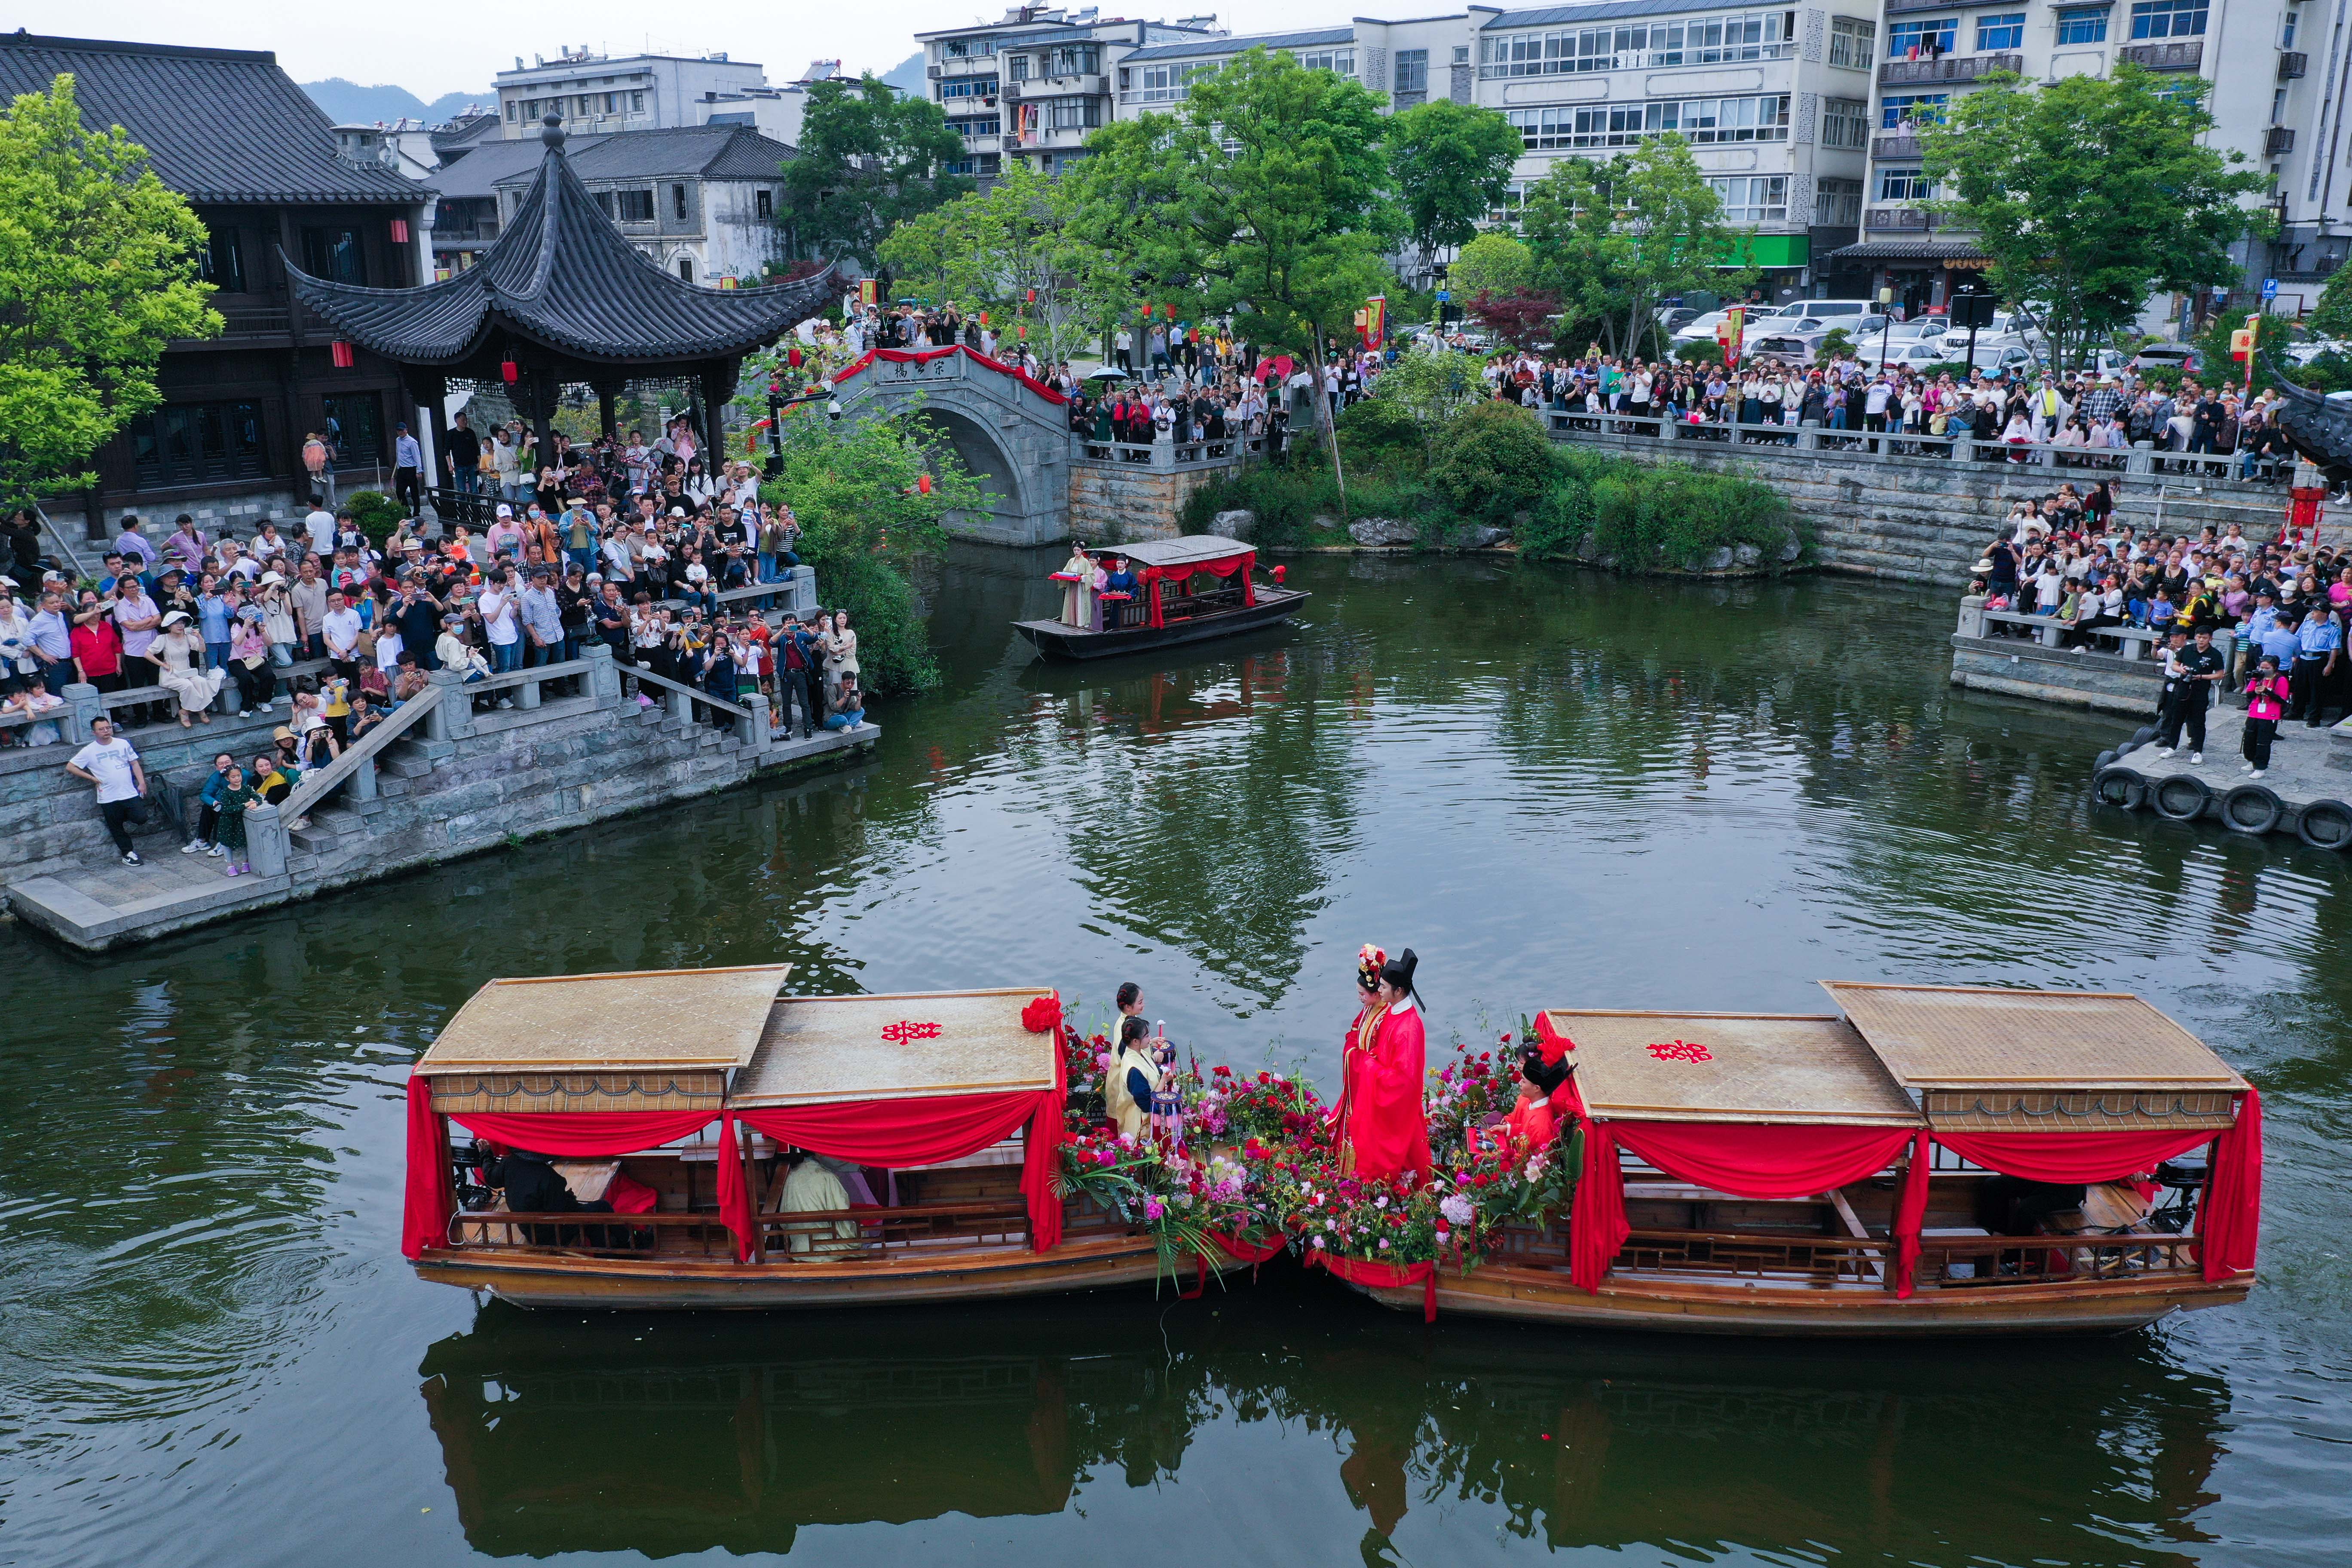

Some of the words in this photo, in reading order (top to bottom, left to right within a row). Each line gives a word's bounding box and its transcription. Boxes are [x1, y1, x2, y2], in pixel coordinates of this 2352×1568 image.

[2267, 281, 2274, 289] P
[2185, 314, 2190, 328] P
[881, 1020, 943, 1046] 囍
[1645, 1039, 1713, 1064] 囍
